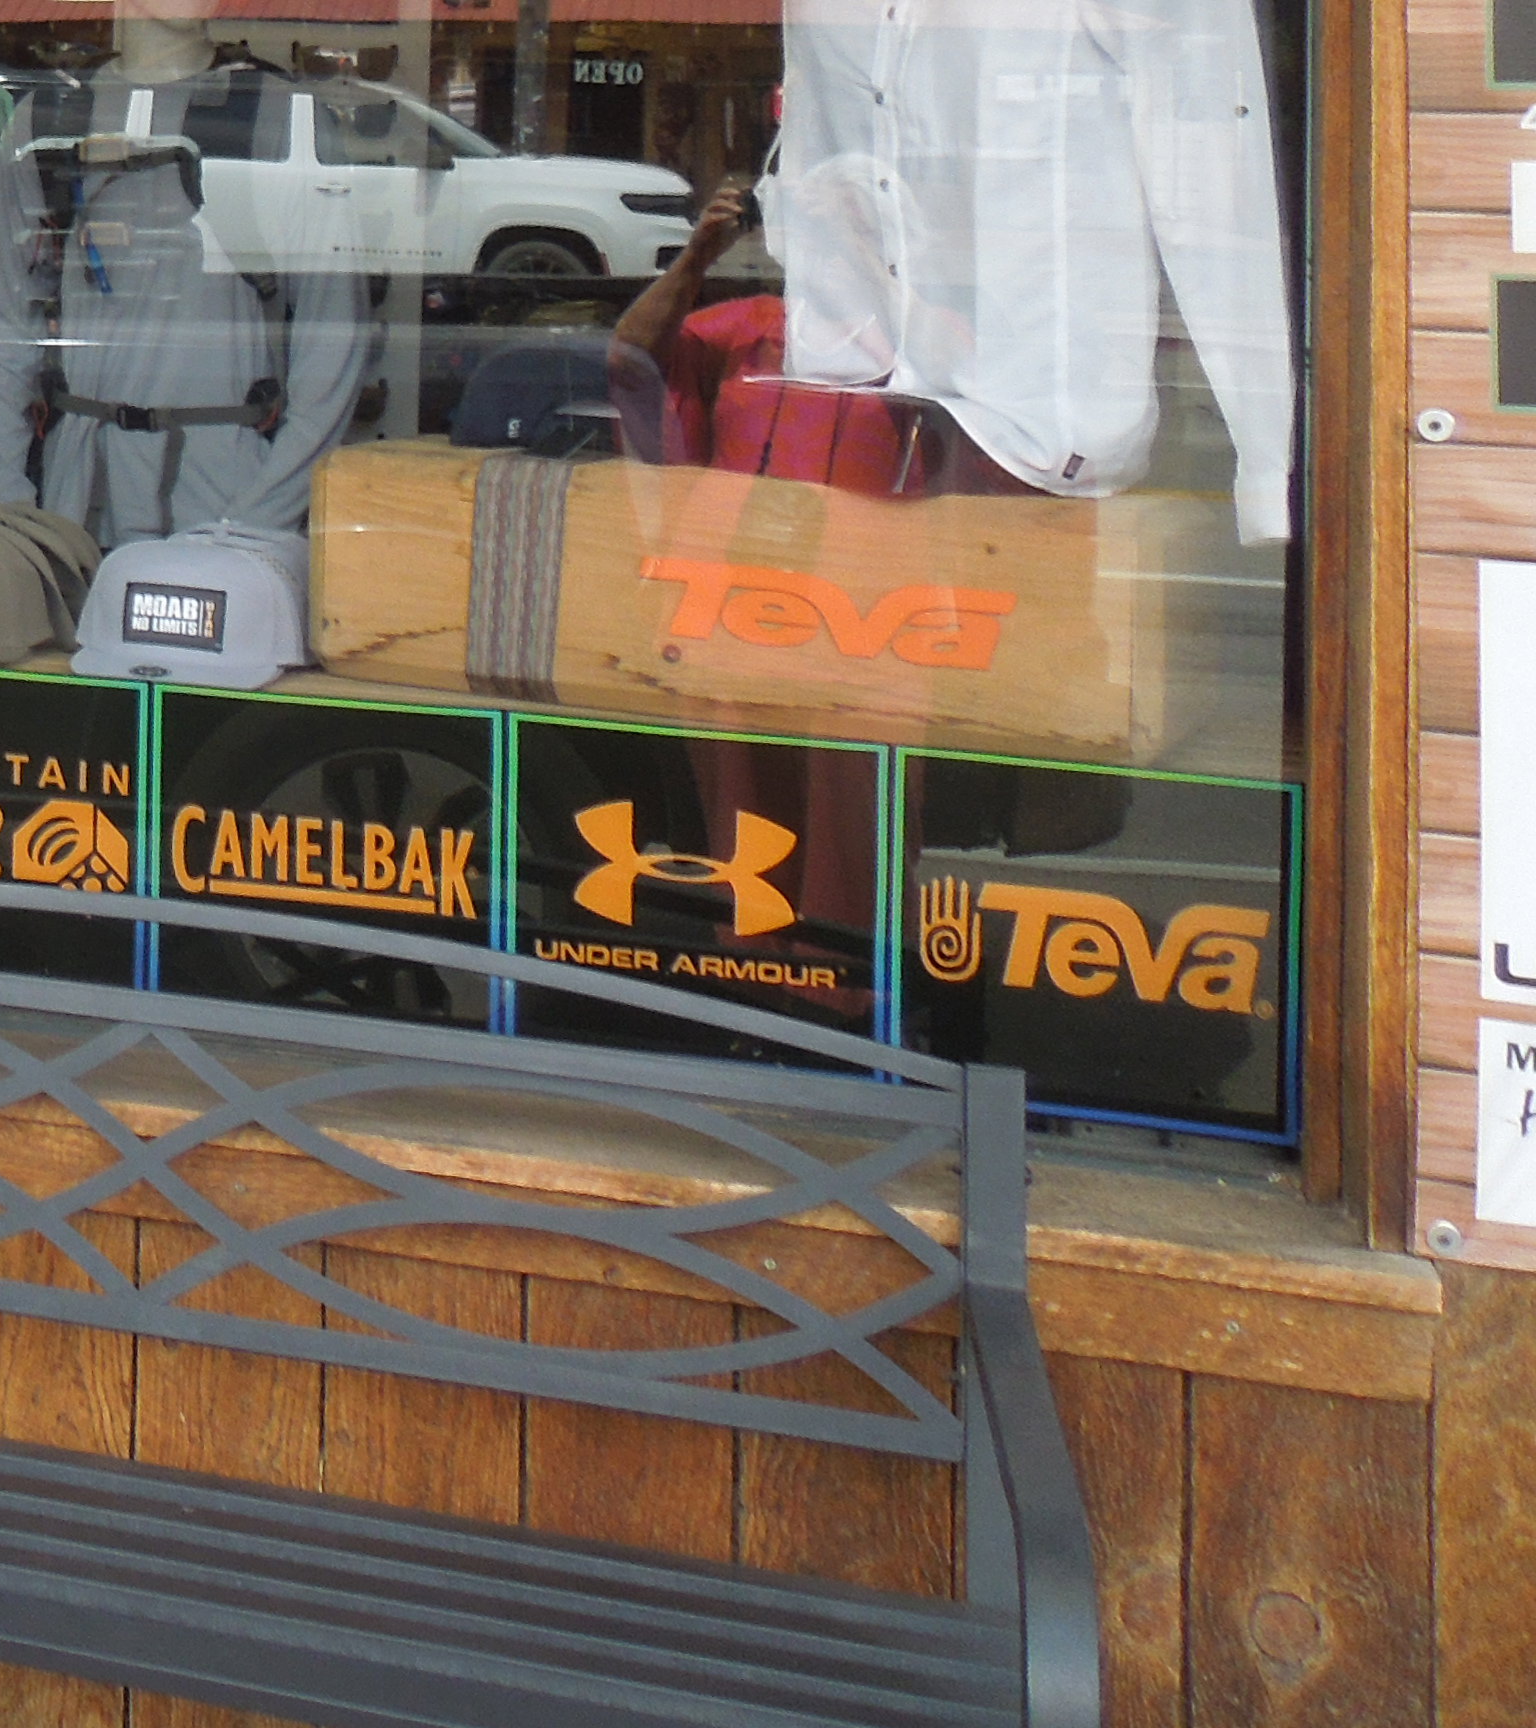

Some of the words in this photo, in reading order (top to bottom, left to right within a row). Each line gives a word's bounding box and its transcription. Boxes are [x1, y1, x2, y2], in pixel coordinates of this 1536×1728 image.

[131, 616, 150, 632] NO
[152, 617, 199, 637] LIMITS
[133, 592, 199, 620] MOAB
[638, 556, 1017, 670] Teva
[171, 802, 477, 919] CAMELBAK
[533, 938, 660, 974] UNDER
[671, 953, 836, 990] ARMOUR
[976, 880, 1271, 1015] Teva
